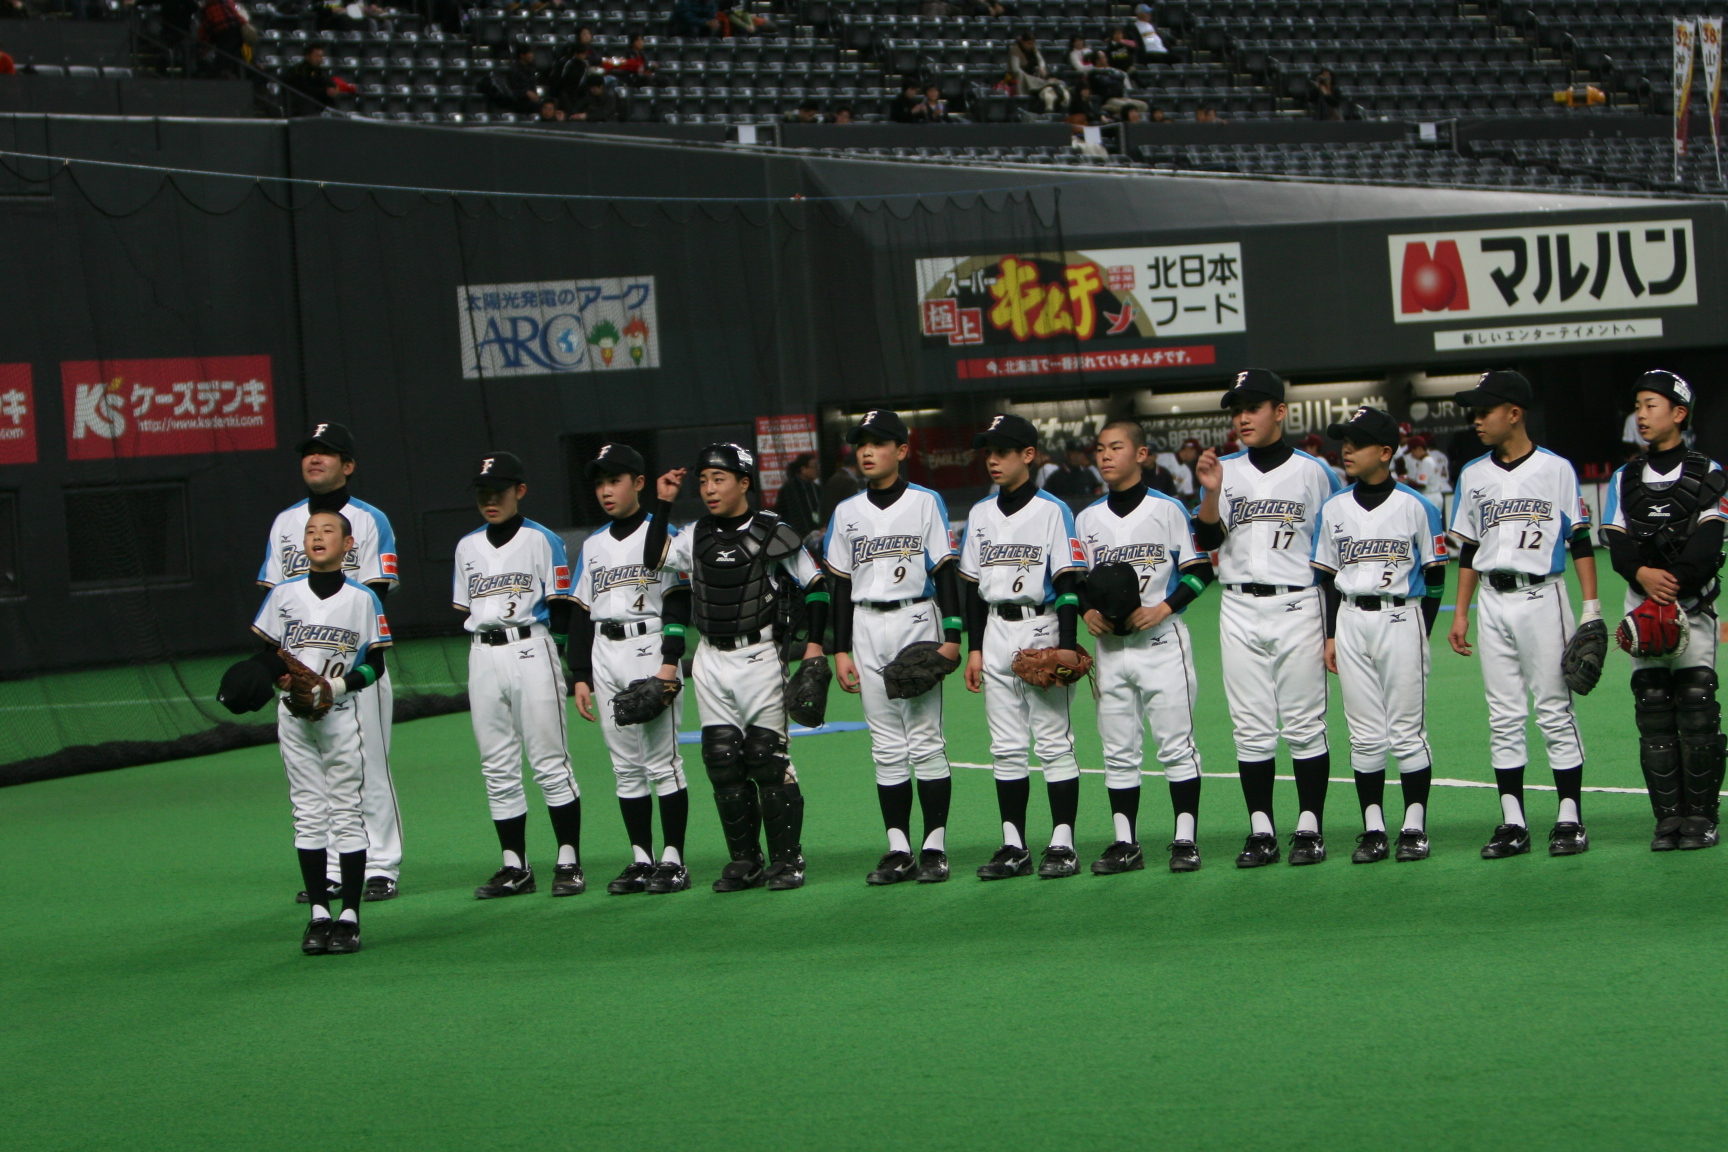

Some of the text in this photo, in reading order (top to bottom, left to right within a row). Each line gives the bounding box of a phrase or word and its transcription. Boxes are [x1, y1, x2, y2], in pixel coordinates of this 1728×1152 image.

[1147, 253, 1238, 290] 北日本
[1480, 227, 1687, 307] マルハン
[946, 268, 997, 296] スーパー
[989, 255, 1103, 341] キムチ
[1151, 292, 1238, 326] フード
[928, 303, 980, 341] 極上
[470, 313, 586, 371] ARC
[1462, 322, 1636, 346] 新しいエンターテイメントへ
[1234, 371, 1249, 389] F
[1474, 372, 1489, 389] F
[0, 388, 28, 425] キ
[131, 379, 267, 417] ケーズデンキ
[862, 410, 878, 426] F
[988, 415, 1004, 431] F
[1349, 409, 1367, 423] F
[312, 423, 328, 438] F
[597, 445, 612, 460] F
[480, 458, 495, 475] F
[1229, 496, 1305, 531] FIGHTERS
[1479, 498, 1553, 537] FIGHTERS
[1271, 531, 1297, 550] 17
[1518, 530, 1544, 550] 12
[851, 534, 923, 570] FIGHTERS
[979, 540, 1042, 567] FIGHTERS
[1093, 544, 1165, 565] FIGHTERS
[1336, 535, 1410, 568] FIGHTERS
[468, 572, 533, 599] FIGHTERS
[893, 566, 907, 584] 9
[1012, 575, 1026, 594] 6
[1379, 571, 1393, 589] 5
[503, 601, 517, 619] 3
[632, 594, 645, 612] 4
[283, 619, 360, 650] FIGHTERS
[320, 658, 345, 679] 10
